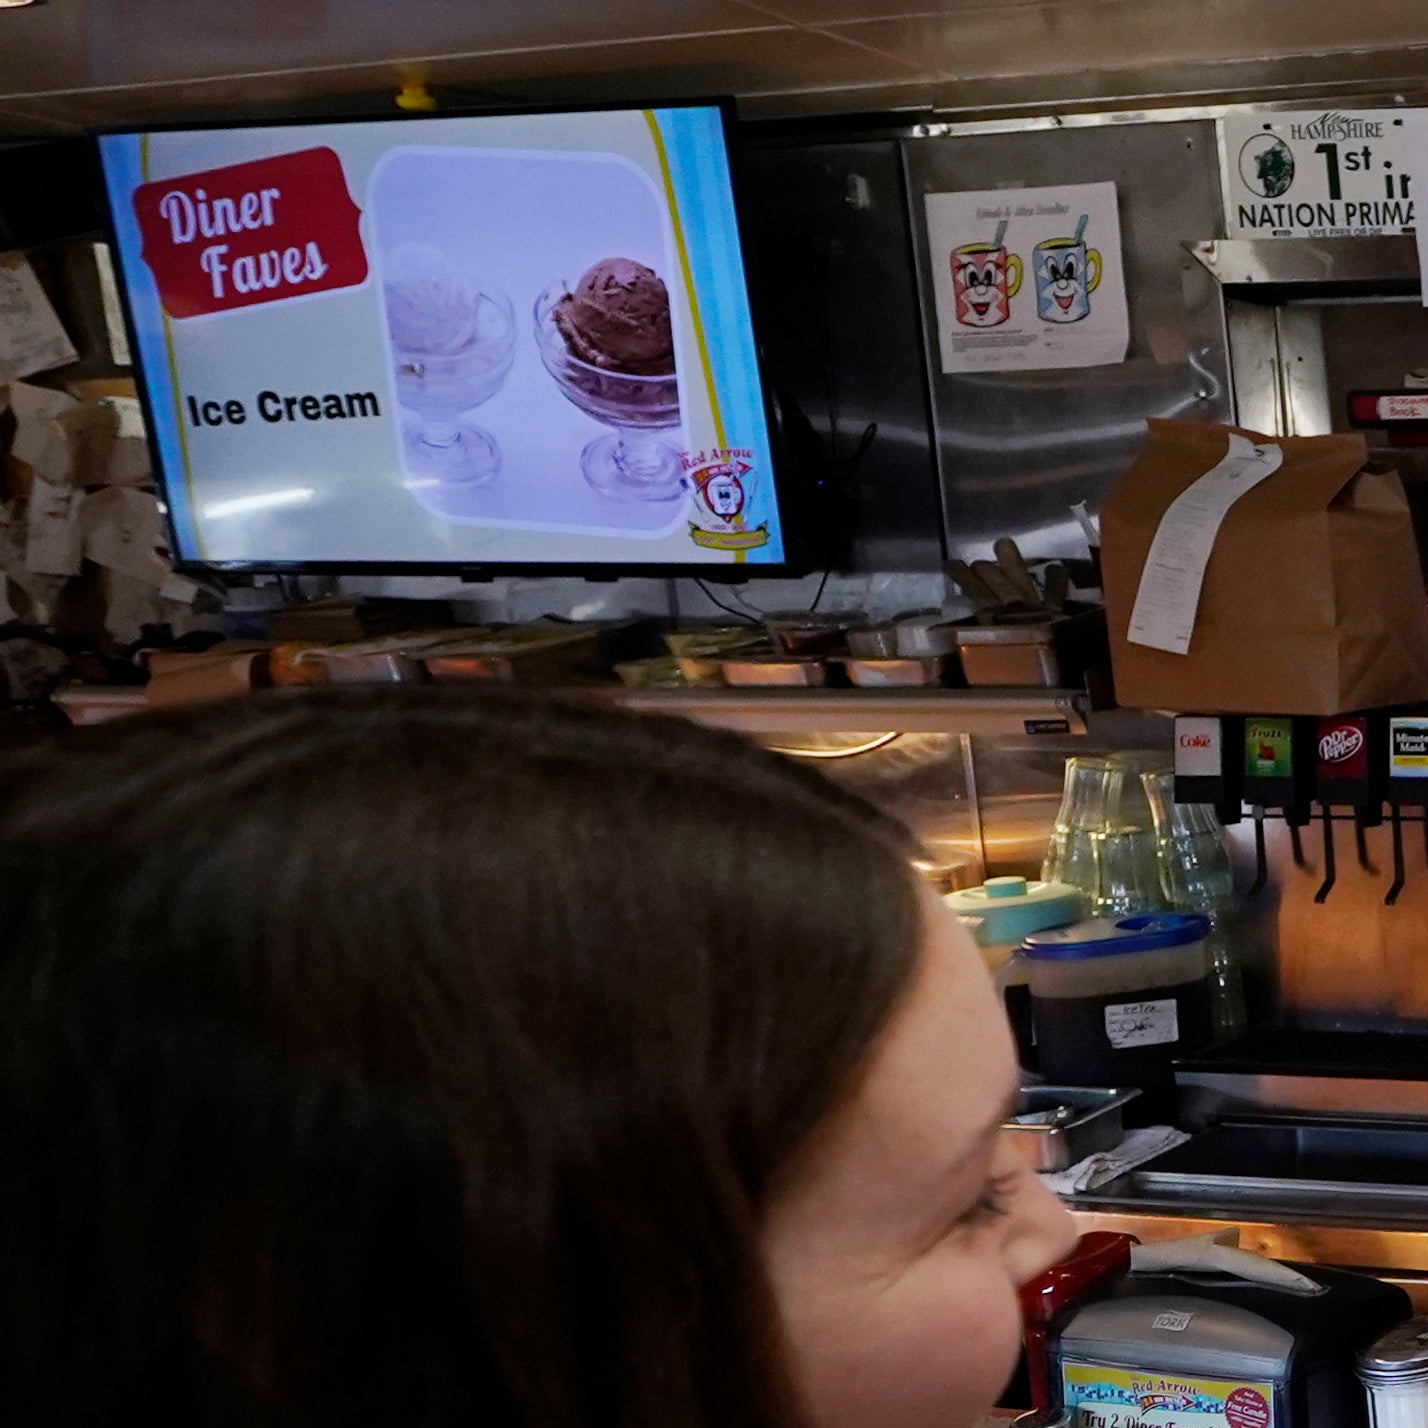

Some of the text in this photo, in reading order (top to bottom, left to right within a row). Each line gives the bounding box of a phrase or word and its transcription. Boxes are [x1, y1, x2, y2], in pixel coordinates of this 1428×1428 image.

[1291, 122, 1385, 141] HAMPSHIRE
[1315, 142, 1372, 200] 1st
[159, 188, 280, 244] Diner
[1238, 202, 1335, 228] NATION
[200, 241, 328, 298] Faves
[187, 390, 381, 427] Ice Cream
[1180, 733, 1211, 749] Coke
[1319, 733, 1360, 760] Pepper
[1331, 730, 1348, 745] Dr
[1400, 743, 1428, 752] Maid
[1155, 1316, 1186, 1328] TORK
[1132, 1380, 1200, 1395] Red Arrow
